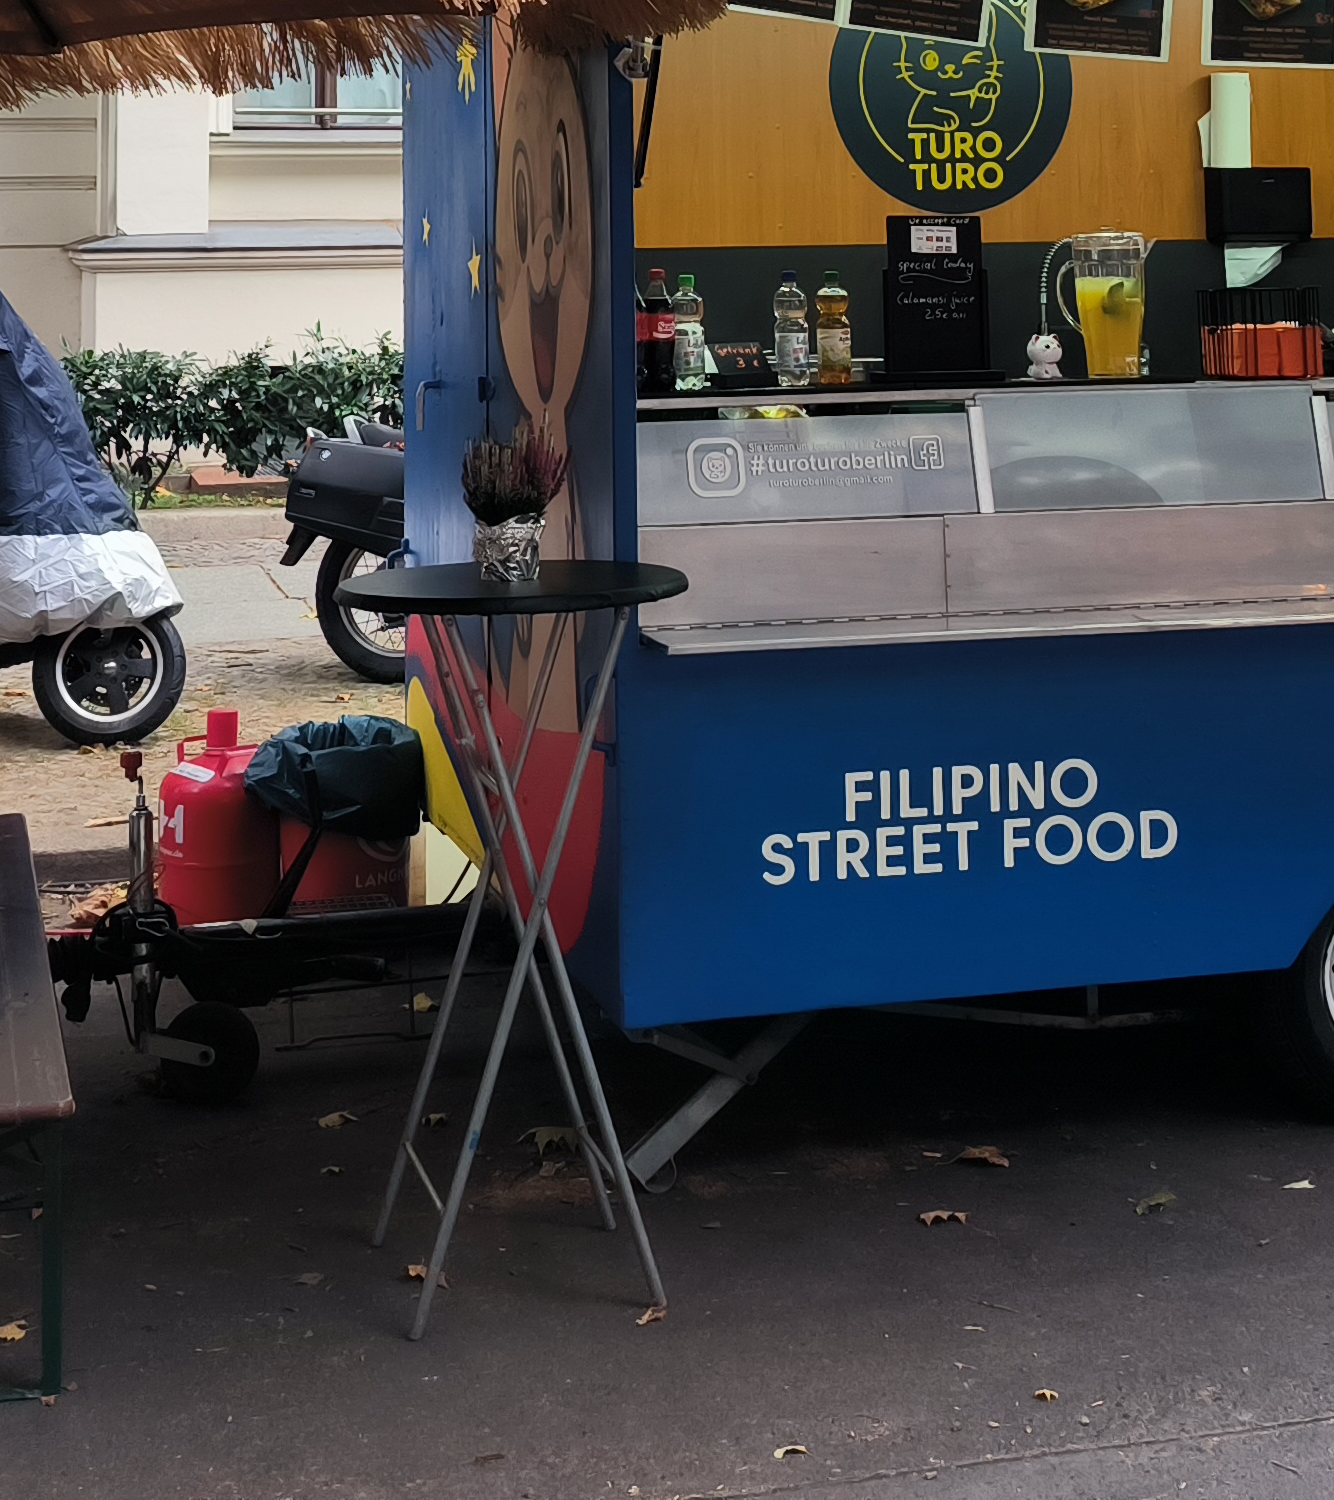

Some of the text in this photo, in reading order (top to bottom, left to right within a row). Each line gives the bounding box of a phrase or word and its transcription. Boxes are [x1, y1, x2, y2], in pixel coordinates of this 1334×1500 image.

[907, 130, 1003, 160] TURO
[908, 161, 1004, 191] TURO
[898, 257, 974, 276] special today
[949, 291, 976, 310] juice
[747, 442, 760, 454] Sie
[763, 441, 795, 453] können
[874, 437, 907, 449] Zwecke
[749, 451, 909, 476] #turoturoberlin
[768, 474, 893, 488] turoturoberlin@gmail.com
[844, 758, 1099, 822] FILIPINO
[761, 809, 1178, 886] STREET FOOD
